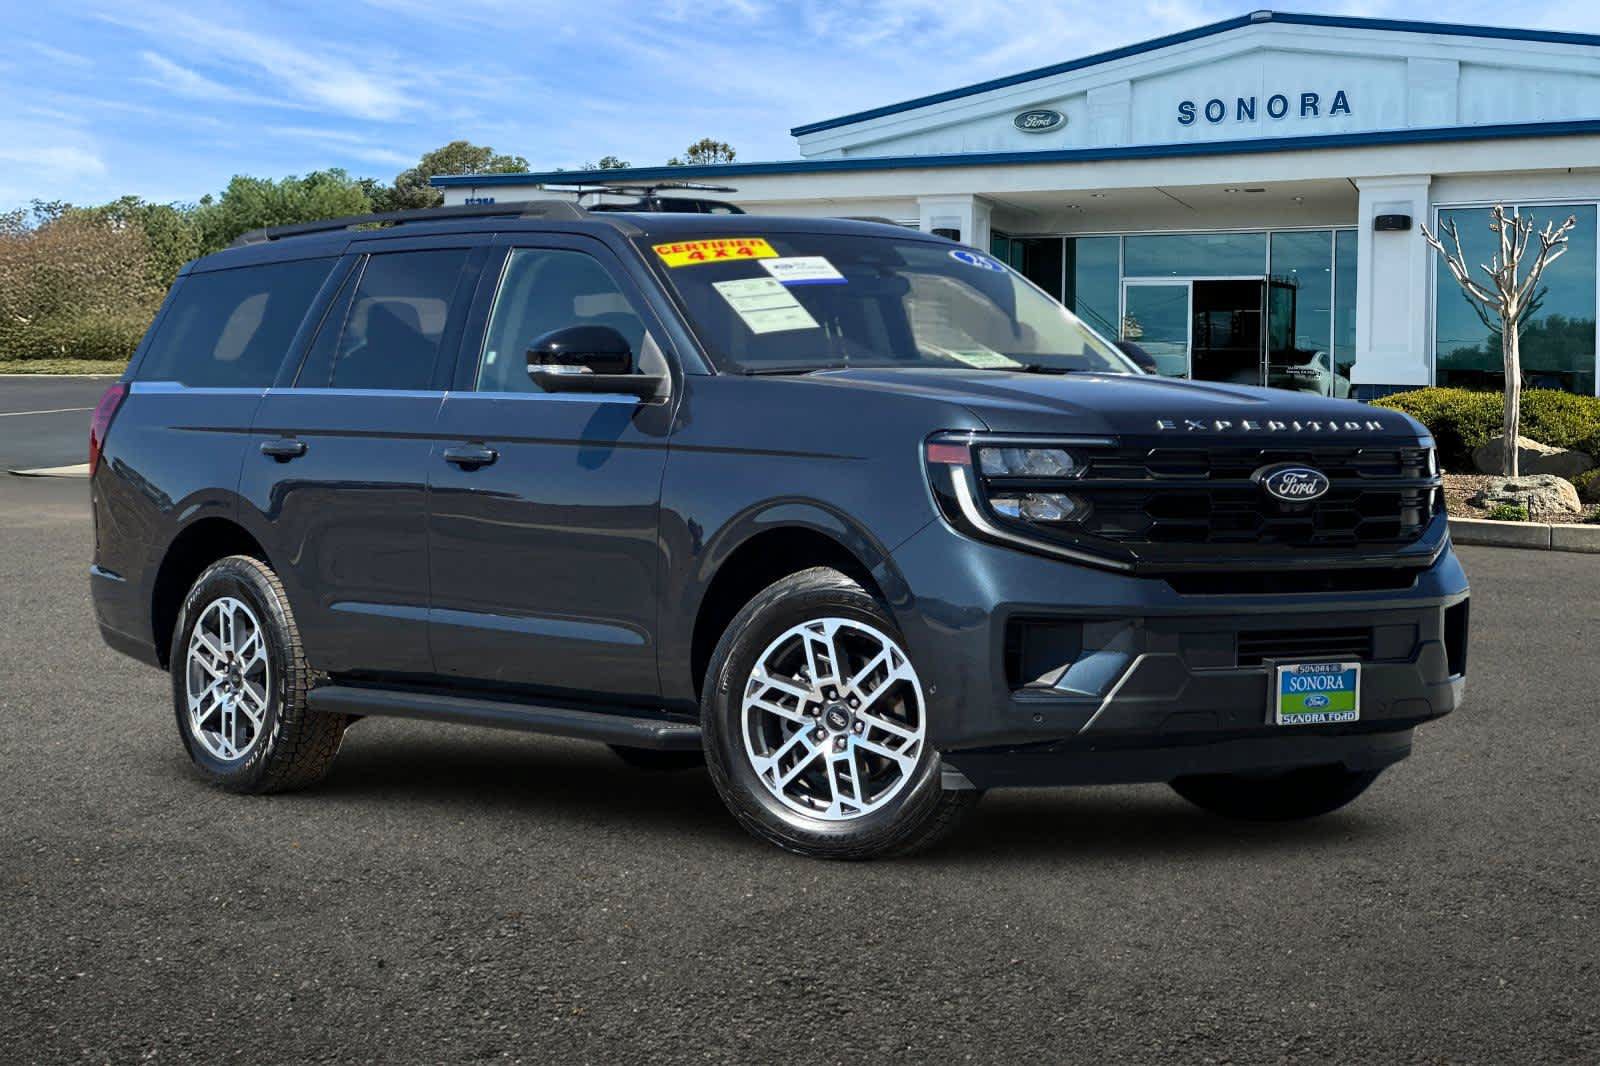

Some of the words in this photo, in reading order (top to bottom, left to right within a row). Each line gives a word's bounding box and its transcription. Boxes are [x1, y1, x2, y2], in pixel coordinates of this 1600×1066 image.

[1176, 90, 1352, 126] SONORA
[656, 238, 765, 255] CERTIFIED
[688, 251, 706, 261] 4
[737, 246, 754, 257] 4
[1156, 418, 1385, 432] EXPEDITION
[1279, 472, 1318, 495] Ford
[1289, 675, 1344, 691] SONORA
[1283, 713, 1326, 724] SONORA
[1328, 711, 1356, 721] FORD
